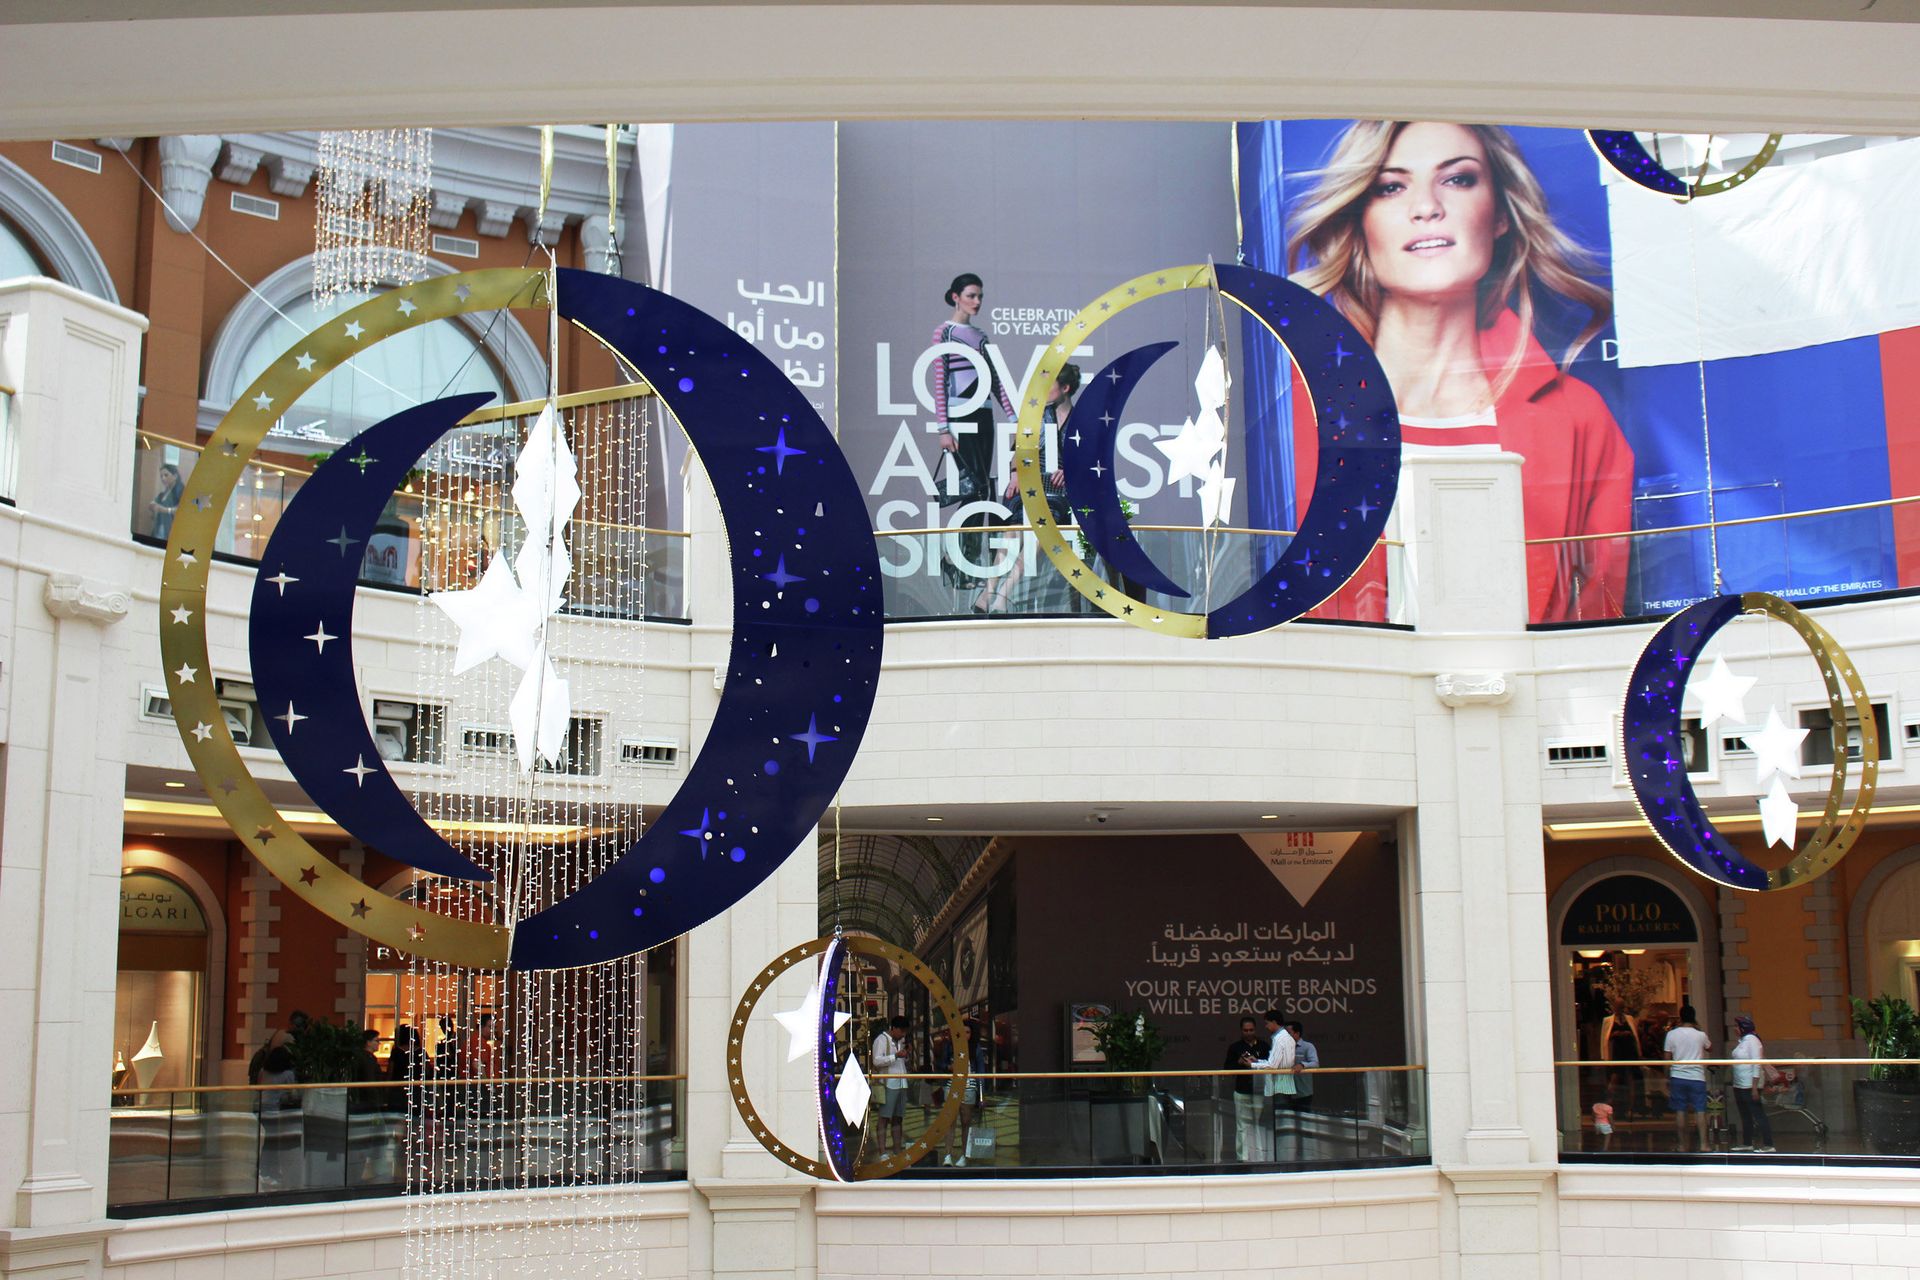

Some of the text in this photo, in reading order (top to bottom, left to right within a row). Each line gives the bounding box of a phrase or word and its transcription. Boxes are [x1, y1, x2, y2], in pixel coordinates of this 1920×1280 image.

[737, 279, 825, 306] الحب
[773, 318, 825, 350] من
[992, 322, 1060, 336] 10 YEARS
[868, 419, 979, 497] AT
[1644, 601, 1661, 610] THE
[1661, 600, 1683, 608] NEW
[1809, 586, 1821, 595] OF
[1822, 584, 1839, 593] THE
[1840, 580, 1882, 592] EMIRATES
[1595, 902, 1662, 922] POLO
[1164, 922, 1336, 944] الماركات المفضلة
[1207, 947, 1282, 967] ستعود
[1287, 944, 1355, 967] لديكم
[1125, 978, 1377, 997] YOUR FAVOURITE BRANDS
[1148, 997, 1354, 1015] WILL BE BACK SOON.
